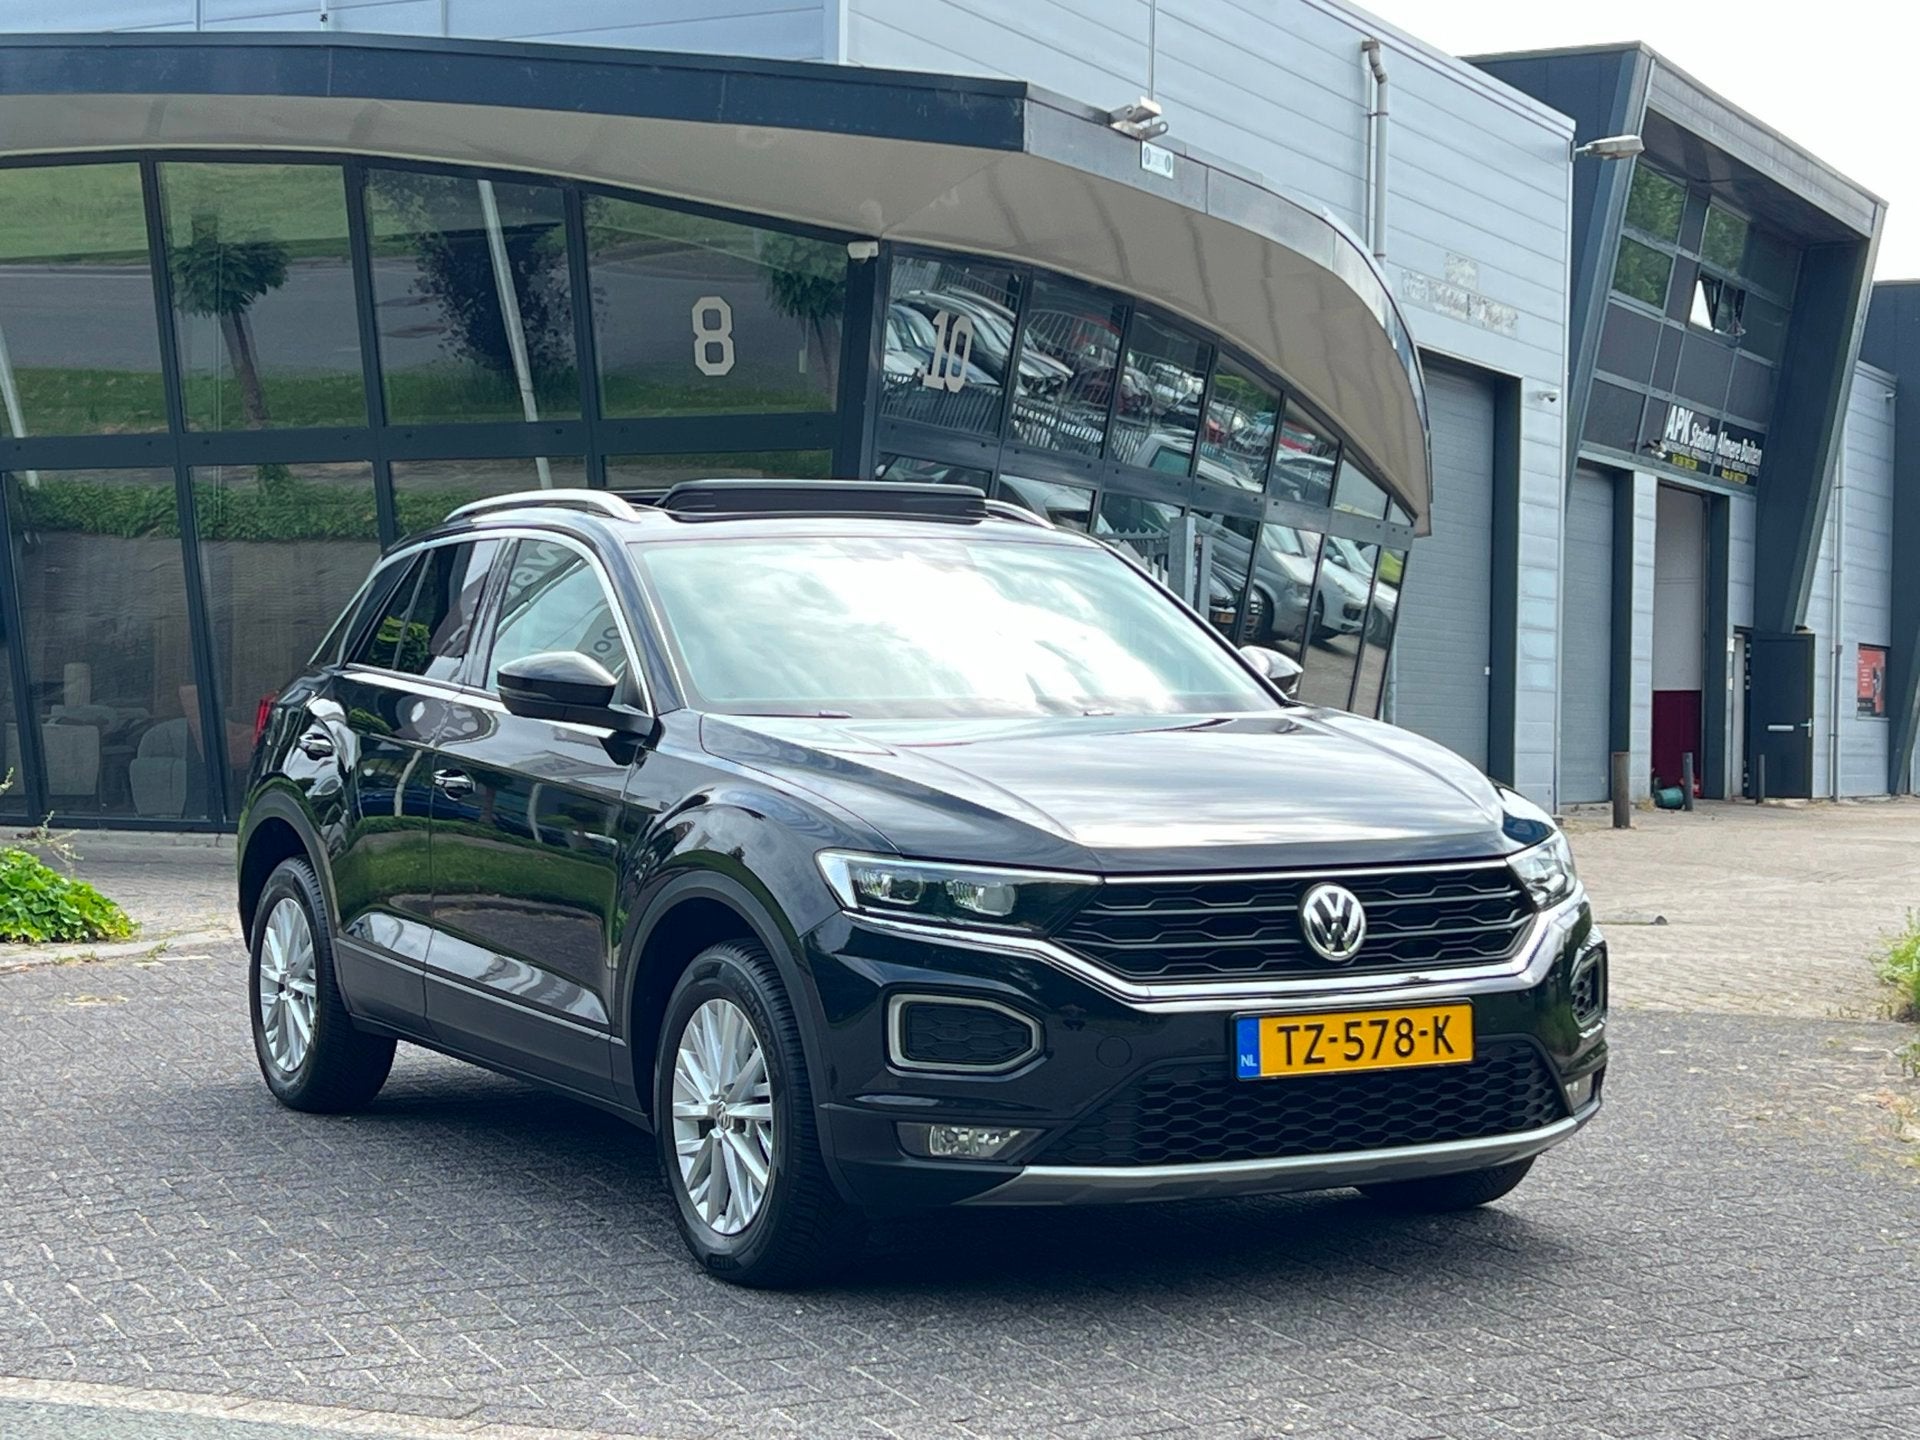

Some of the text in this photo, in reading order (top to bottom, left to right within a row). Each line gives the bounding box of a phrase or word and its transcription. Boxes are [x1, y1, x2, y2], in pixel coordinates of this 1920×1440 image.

[691, 295, 736, 376] 8
[922, 309, 975, 393] 10
[1665, 405, 1694, 445] APK
[1690, 422, 1717, 452] Station
[1240, 1054, 1258, 1068] NL
[1277, 1015, 1455, 1066] TZ-578-K
